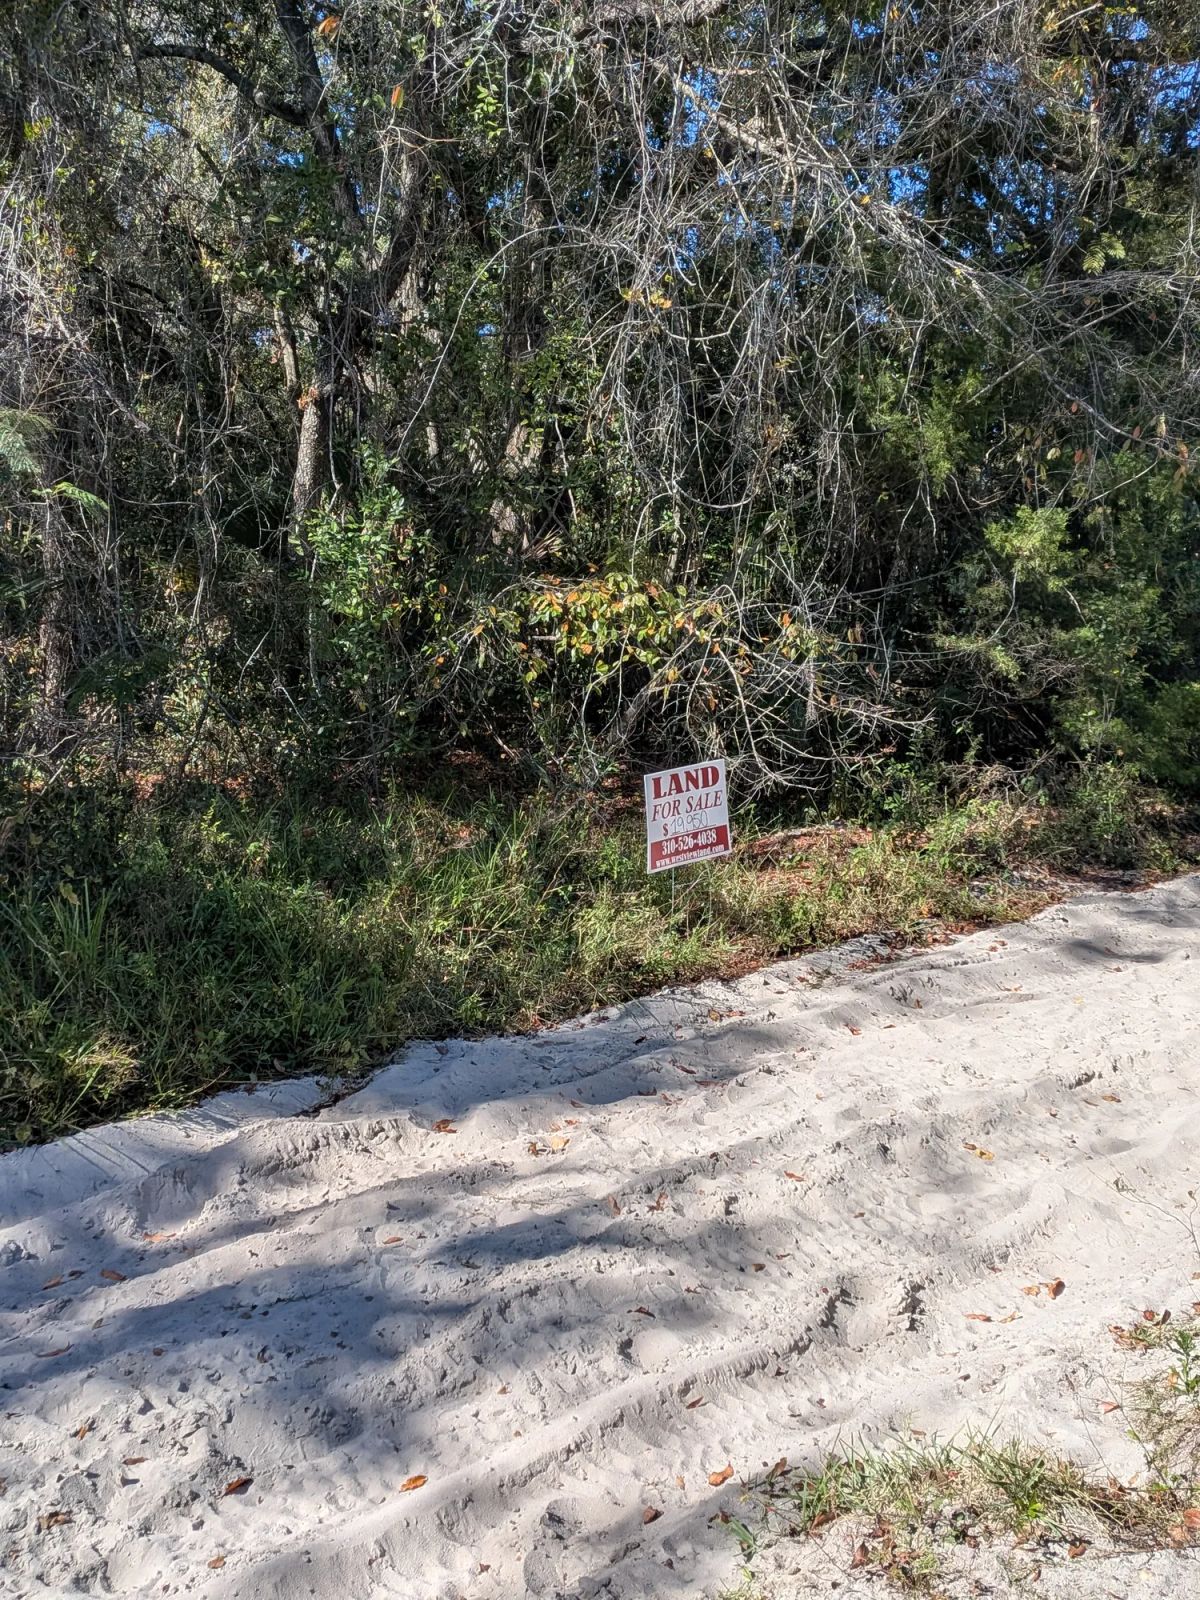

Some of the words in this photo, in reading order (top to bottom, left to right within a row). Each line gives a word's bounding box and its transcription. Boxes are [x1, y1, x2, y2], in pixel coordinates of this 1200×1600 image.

[652, 765, 720, 800] LAND
[651, 799, 681, 822] FOR
[685, 790, 723, 813] SALE
[655, 844, 725, 869] www.westviewland.com
[661, 829, 717, 856] 310-526-4038
